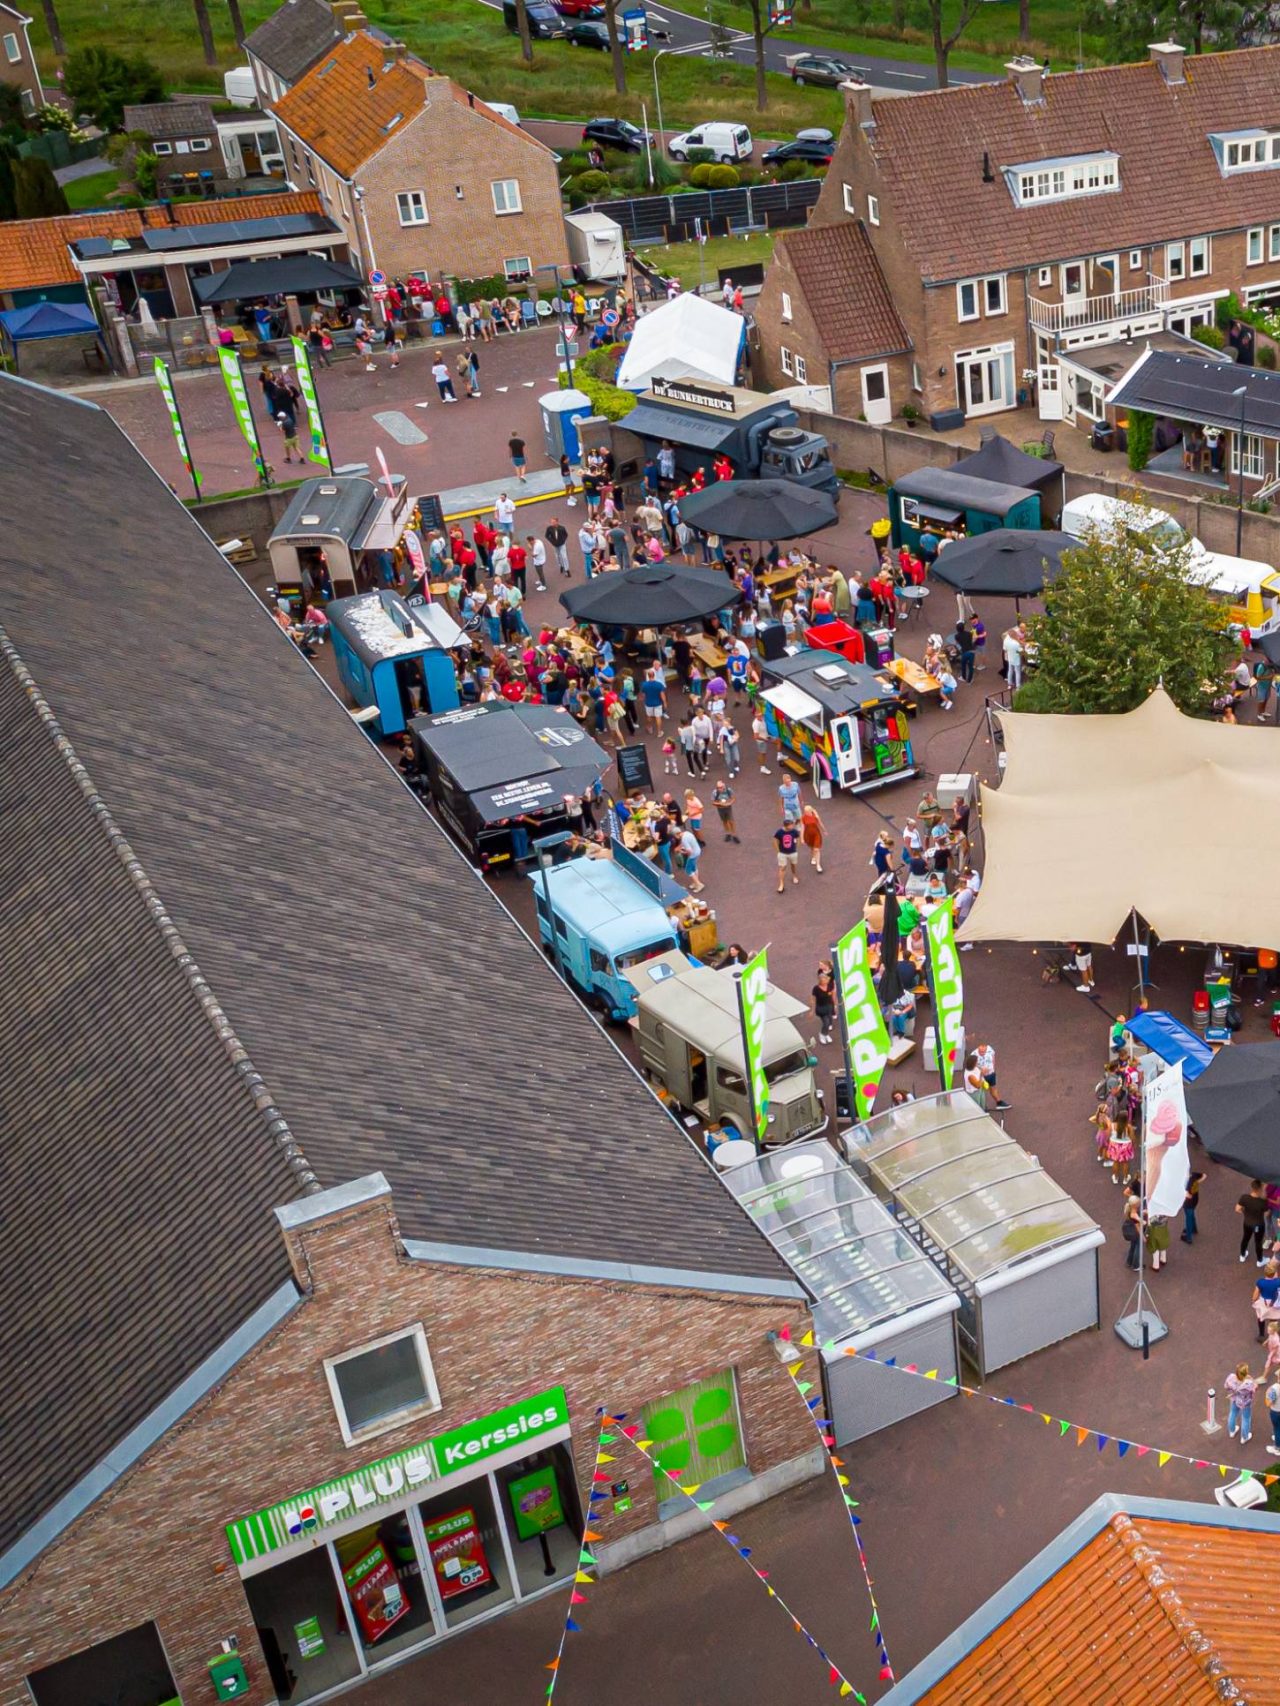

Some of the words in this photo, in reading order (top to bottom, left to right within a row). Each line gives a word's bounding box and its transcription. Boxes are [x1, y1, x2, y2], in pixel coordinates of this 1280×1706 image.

[667, 388, 733, 412] BUNKERTRUCK
[843, 936, 888, 1077] PLUS
[319, 1455, 432, 1522] PLUS
[439, 1516, 470, 1534] PLUS
[355, 1550, 382, 1576] PLUS
